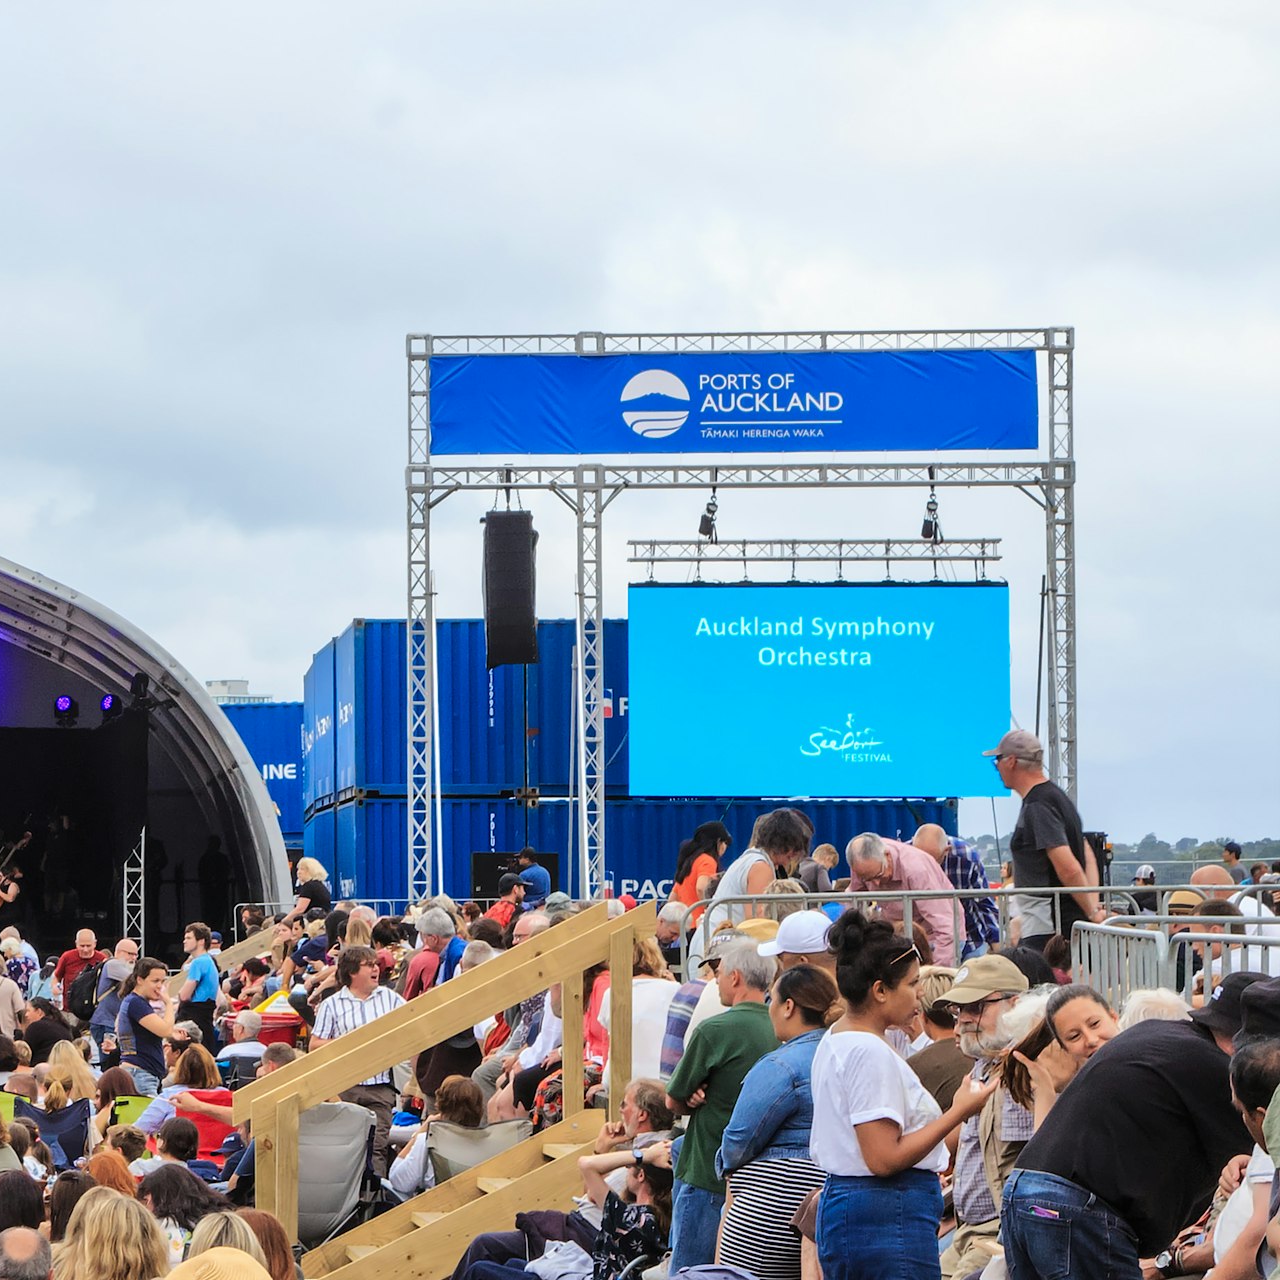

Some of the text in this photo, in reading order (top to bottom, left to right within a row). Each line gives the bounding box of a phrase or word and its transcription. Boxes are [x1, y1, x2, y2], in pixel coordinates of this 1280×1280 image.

[699, 372, 795, 391] PORTS OF
[700, 391, 844, 413] AUCKLAND
[700, 426, 825, 439] TĀMAKI HERENGA WAKA
[696, 615, 935, 642] Auckland Symphony
[757, 645, 872, 666] Orchestra
[844, 753, 892, 762] FESTIVAL
[262, 763, 297, 780] INE
